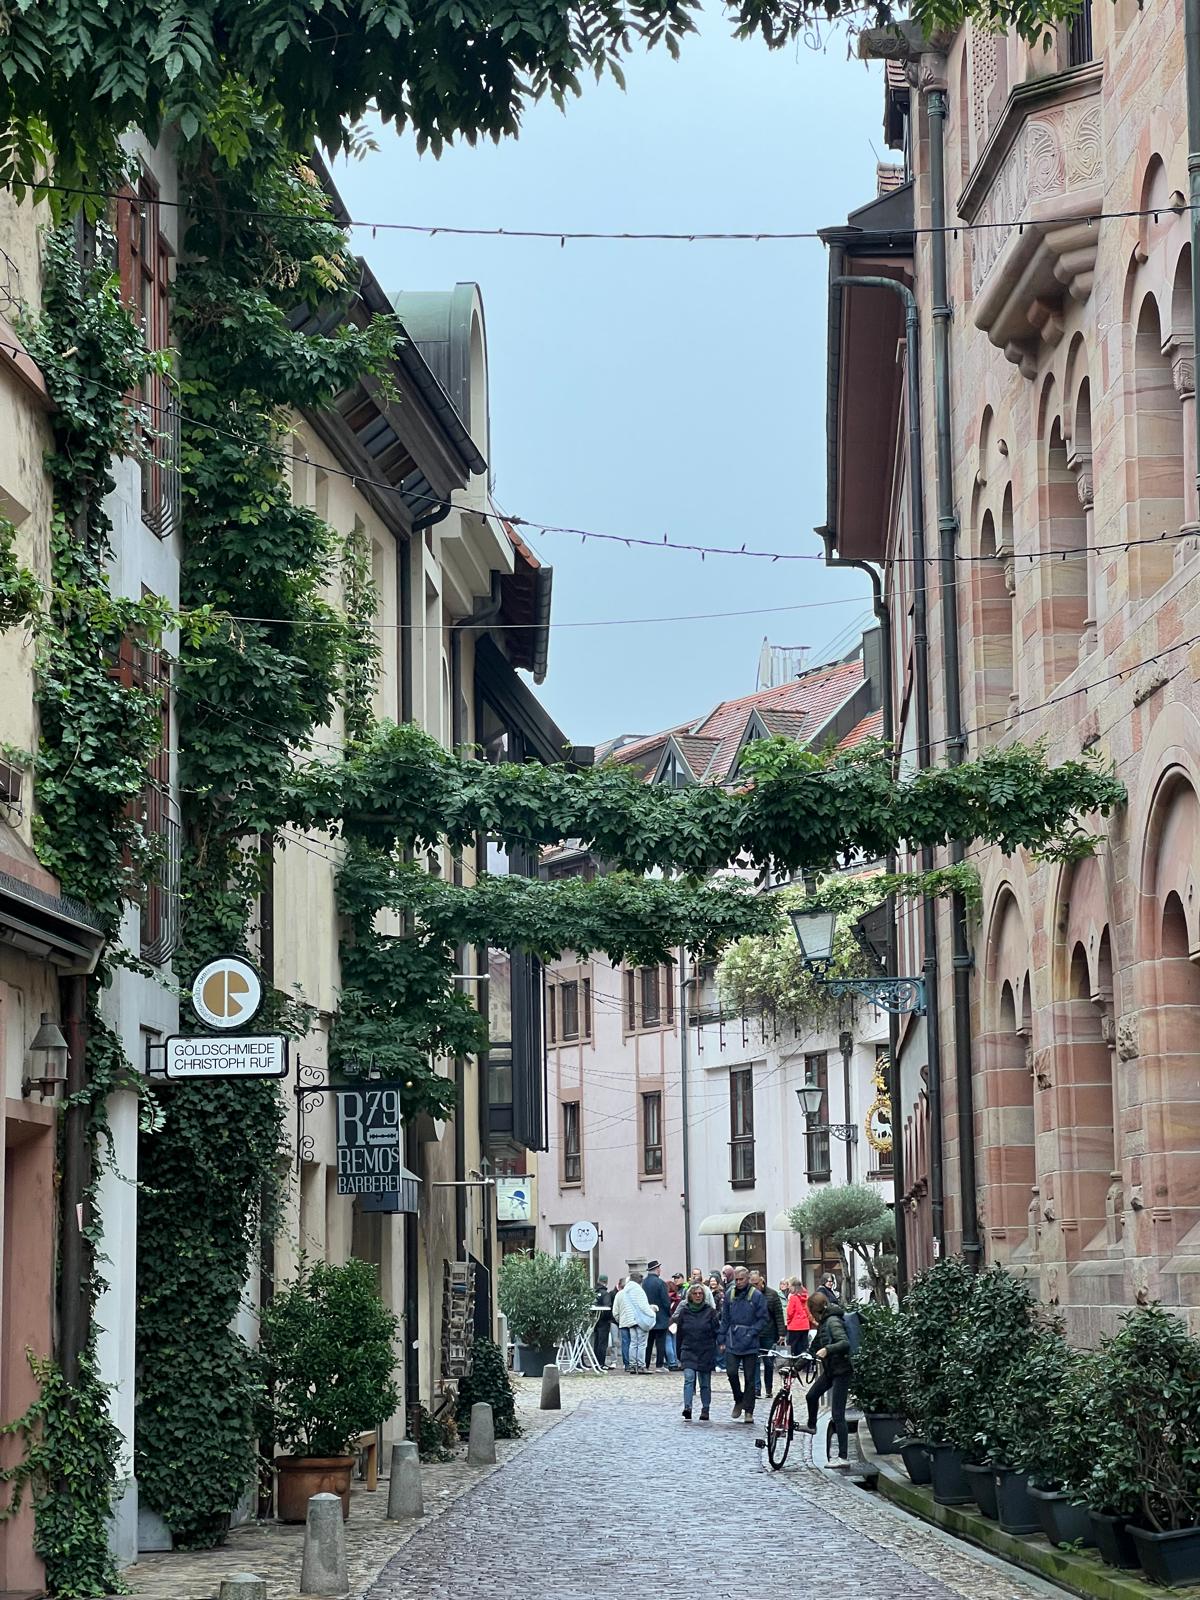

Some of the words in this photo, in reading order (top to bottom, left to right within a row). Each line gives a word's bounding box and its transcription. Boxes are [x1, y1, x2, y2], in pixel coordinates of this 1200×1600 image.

[174, 1043, 275, 1056] GOLDSCHMIEDE
[174, 1058, 245, 1070] CHRISTOPH
[250, 1057, 275, 1068] RUF
[338, 1175, 400, 1193] BARBEREI
